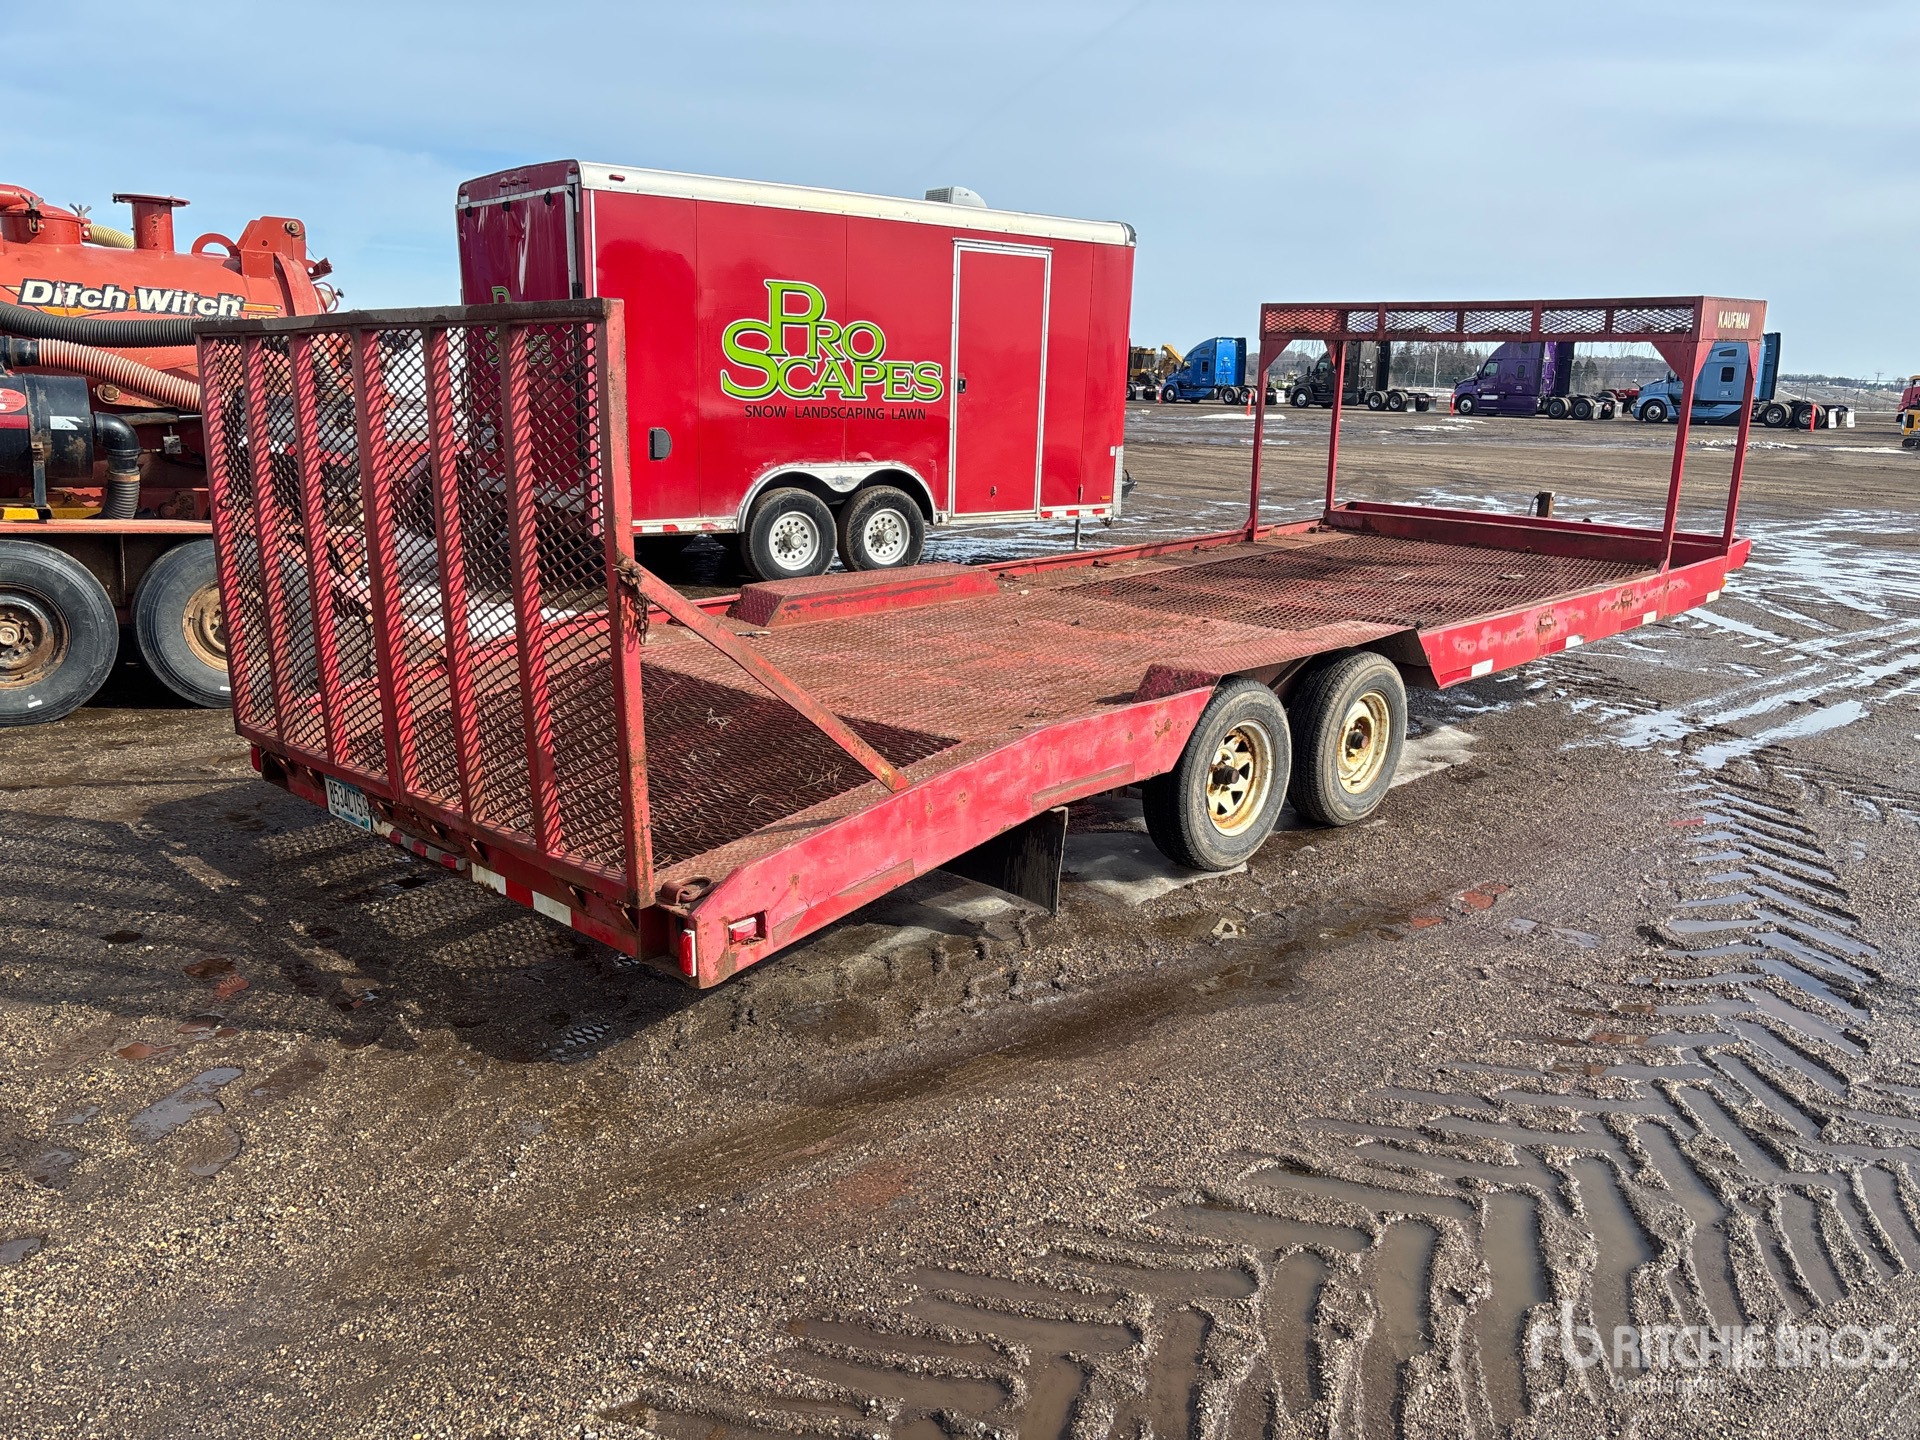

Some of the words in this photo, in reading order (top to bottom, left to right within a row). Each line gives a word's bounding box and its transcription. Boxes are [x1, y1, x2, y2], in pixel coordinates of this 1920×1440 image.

[21, 280, 128, 309] Ditch
[137, 286, 241, 317] Witch
[764, 279, 886, 361] PRO
[1717, 310, 1751, 330] KAUFMAN
[720, 318, 944, 402] SCAPES
[744, 405, 788, 419] SNOW
[794, 406, 886, 421] LANDSCAPING
[891, 408, 927, 421] LAWN
